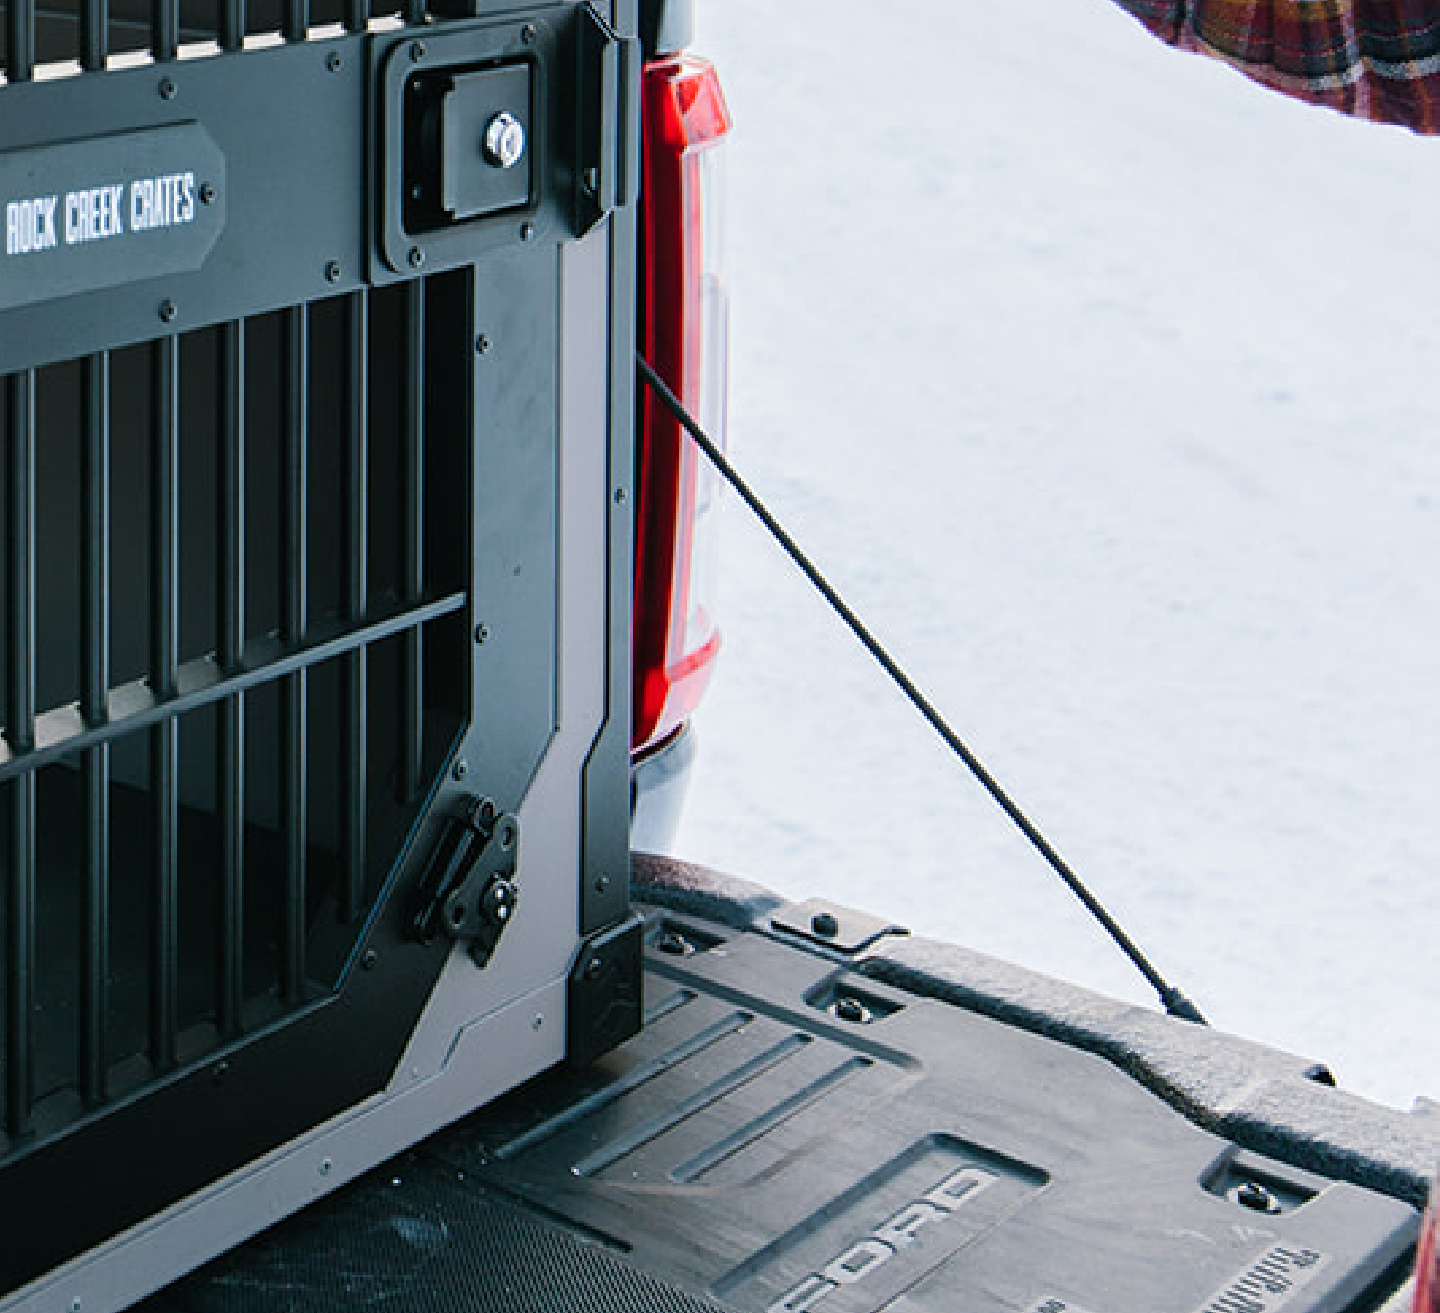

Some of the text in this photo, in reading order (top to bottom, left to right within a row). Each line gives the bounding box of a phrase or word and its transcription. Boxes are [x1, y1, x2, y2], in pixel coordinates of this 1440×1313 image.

[7, 171, 194, 254] ROCK CREEK CRATES
